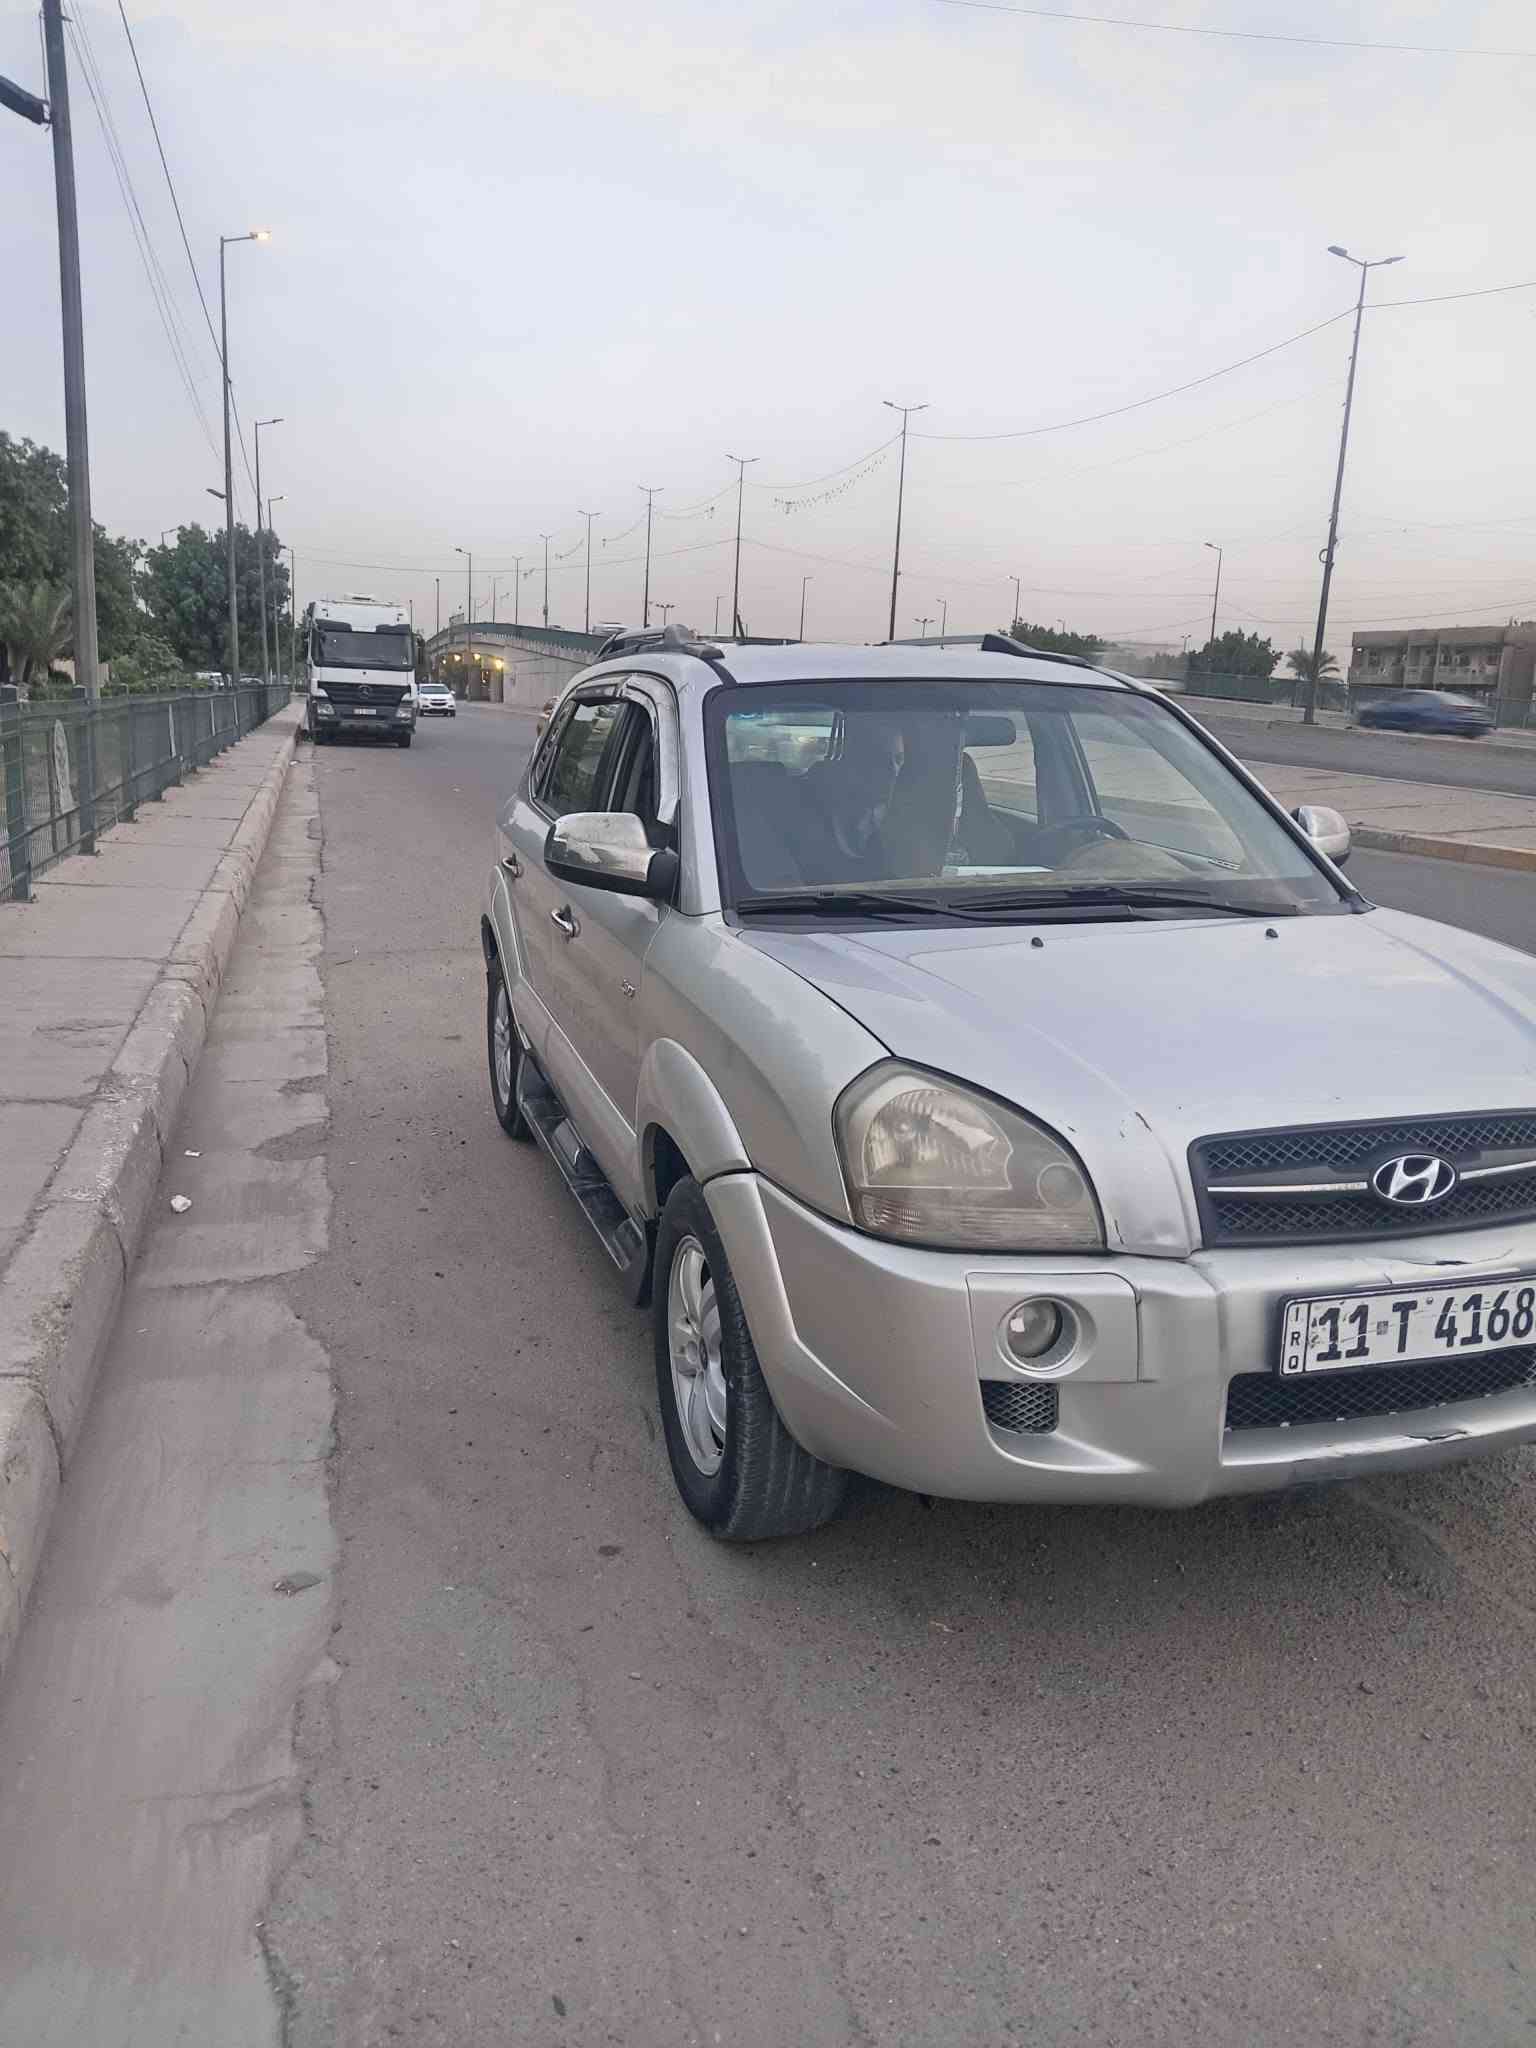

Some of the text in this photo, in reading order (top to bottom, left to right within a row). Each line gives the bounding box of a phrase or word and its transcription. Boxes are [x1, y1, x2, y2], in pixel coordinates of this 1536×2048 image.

[1316, 1304, 1370, 1361] 11
[1391, 1300, 1418, 1353] T
[1434, 1287, 1535, 1348] 4168
